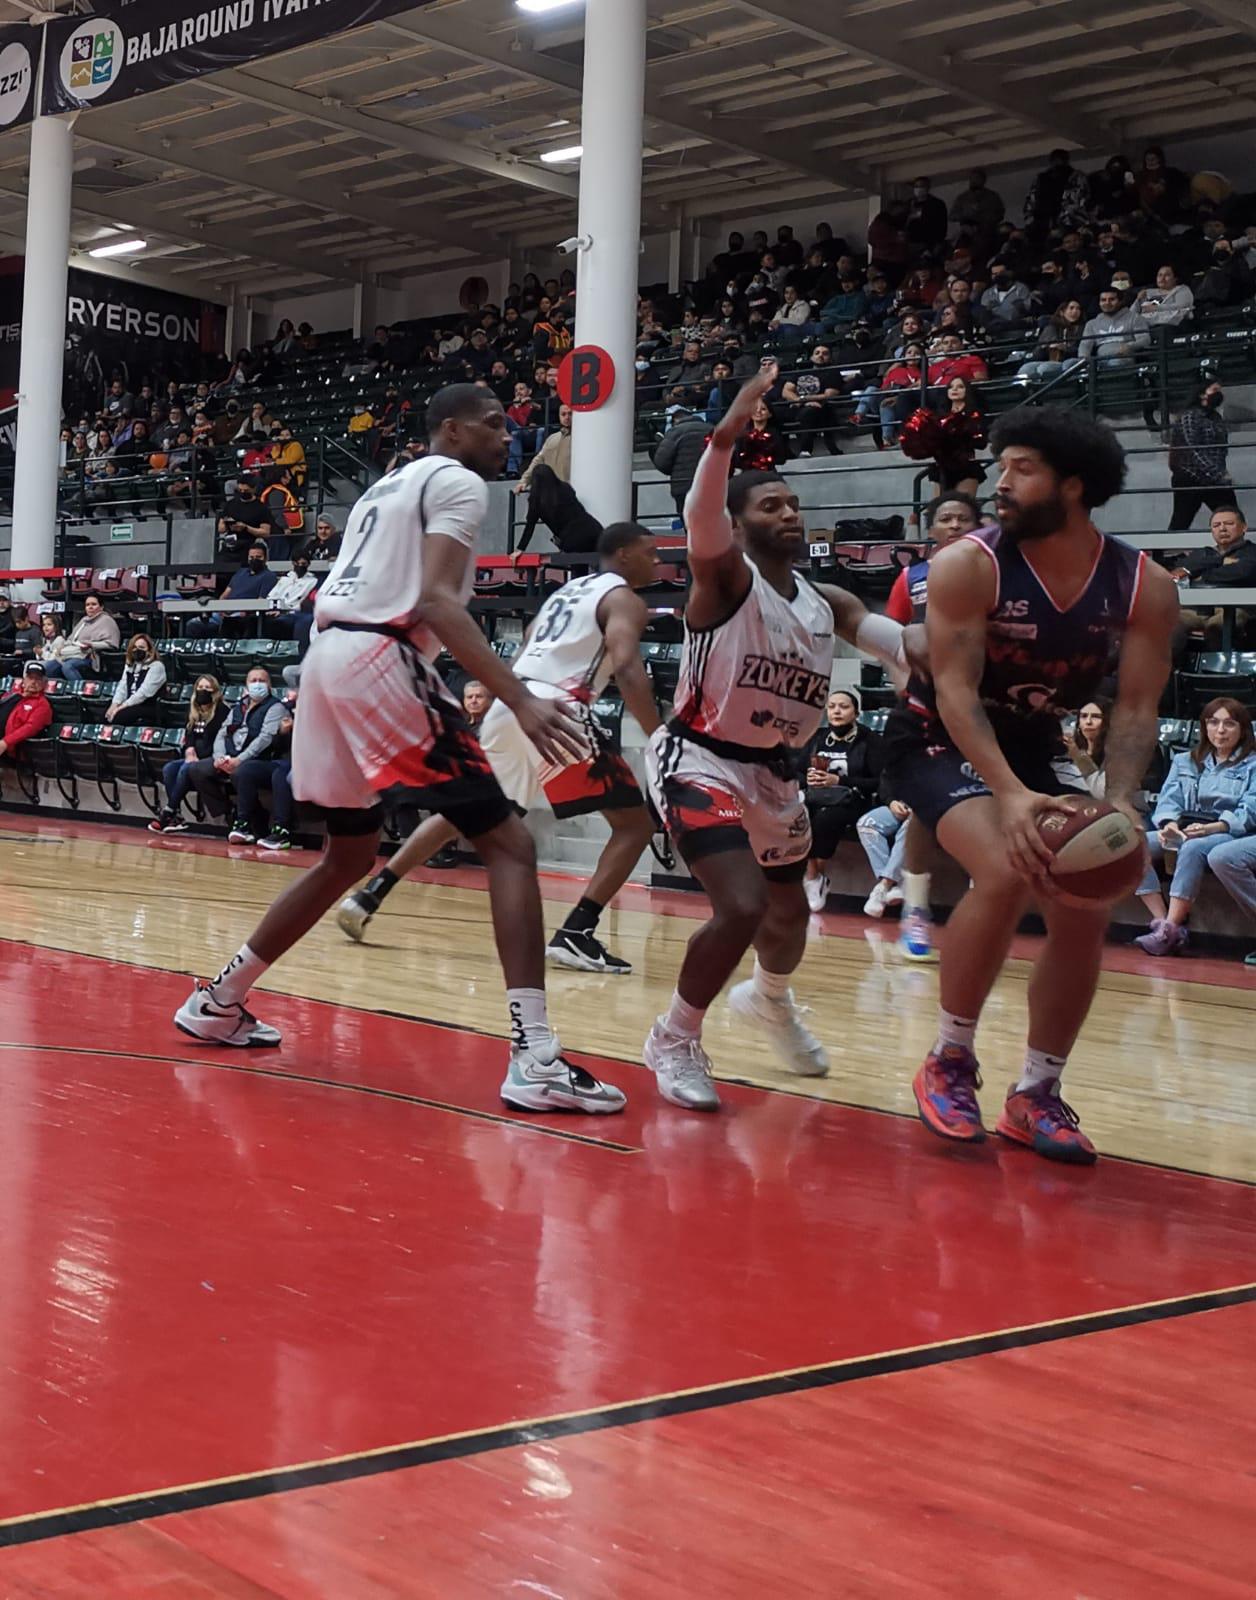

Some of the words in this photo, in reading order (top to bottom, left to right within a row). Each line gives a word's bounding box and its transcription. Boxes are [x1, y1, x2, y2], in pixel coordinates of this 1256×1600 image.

[126, 0, 252, 66] BAJAROUND
[68, 296, 200, 343] RYERSON
[571, 353, 601, 406] B
[338, 506, 379, 581] 2
[535, 597, 580, 644] 35
